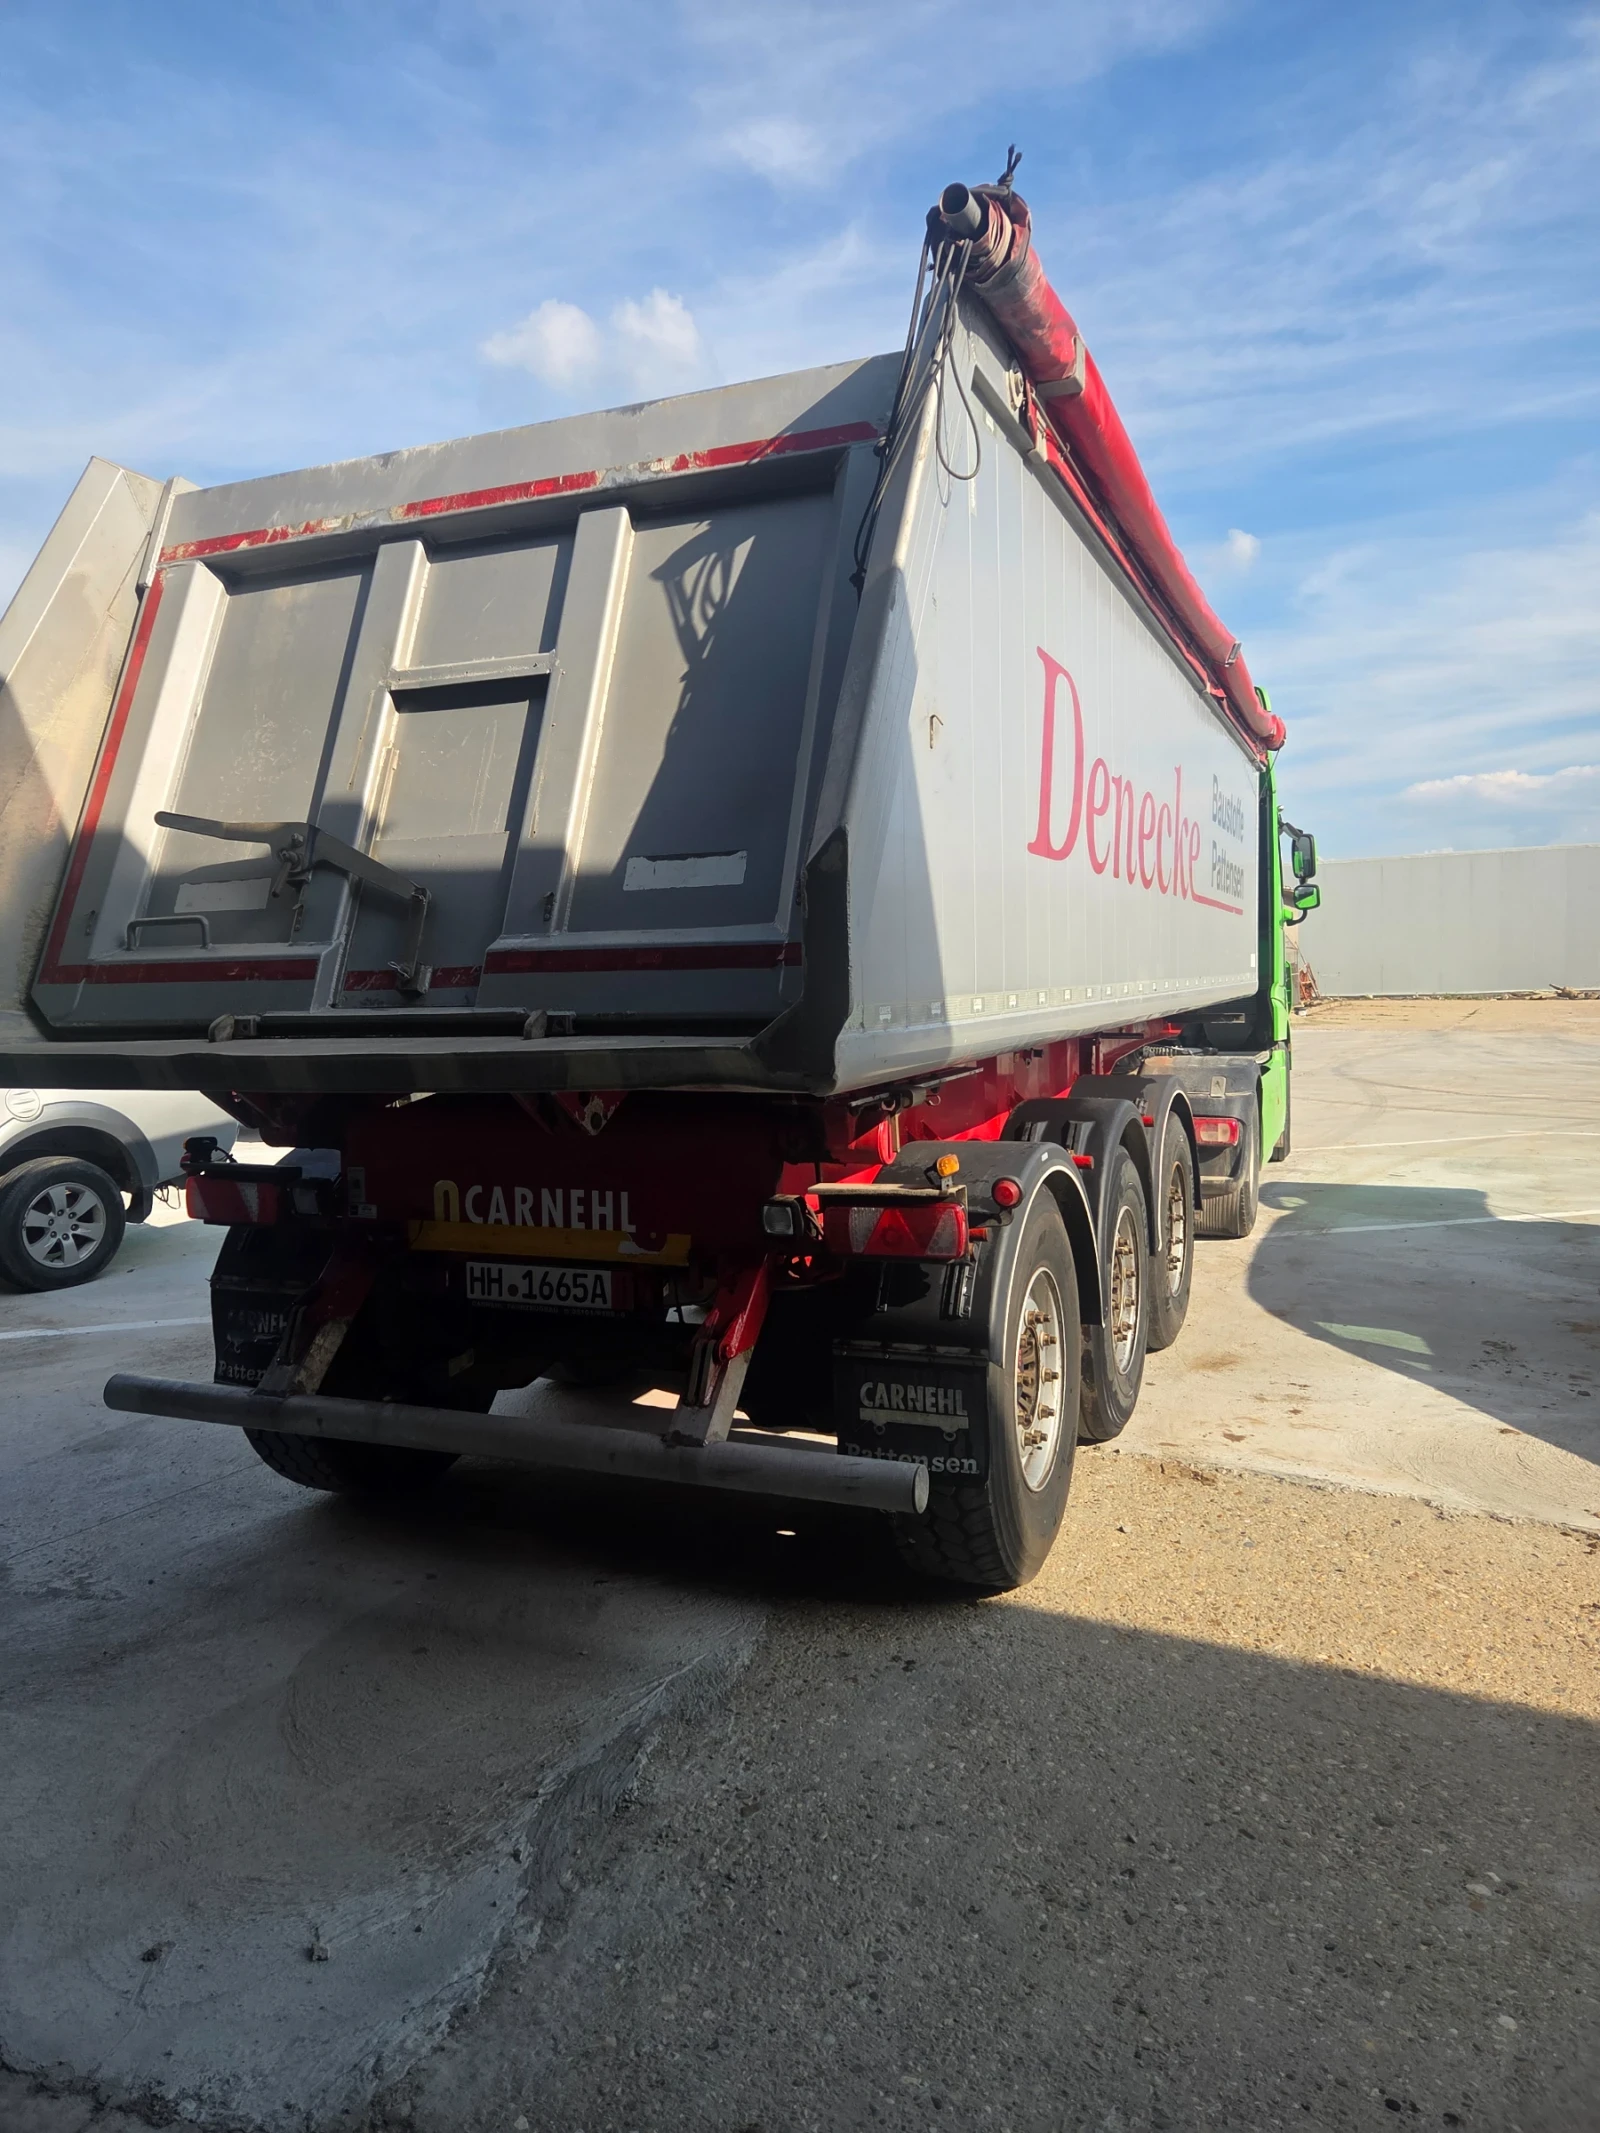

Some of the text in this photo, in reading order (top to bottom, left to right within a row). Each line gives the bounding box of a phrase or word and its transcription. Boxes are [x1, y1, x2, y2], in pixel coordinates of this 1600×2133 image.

[1026, 645, 1201, 901] Denecke
[1212, 773, 1244, 844] Baustoffe
[1211, 840, 1244, 901] Pattensen
[465, 1184, 637, 1234] CARNEHL
[469, 1265, 609, 1306] HH 1665A
[217, 1360, 268, 1381] Patten
[860, 1381, 968, 1416] CARNEHL
